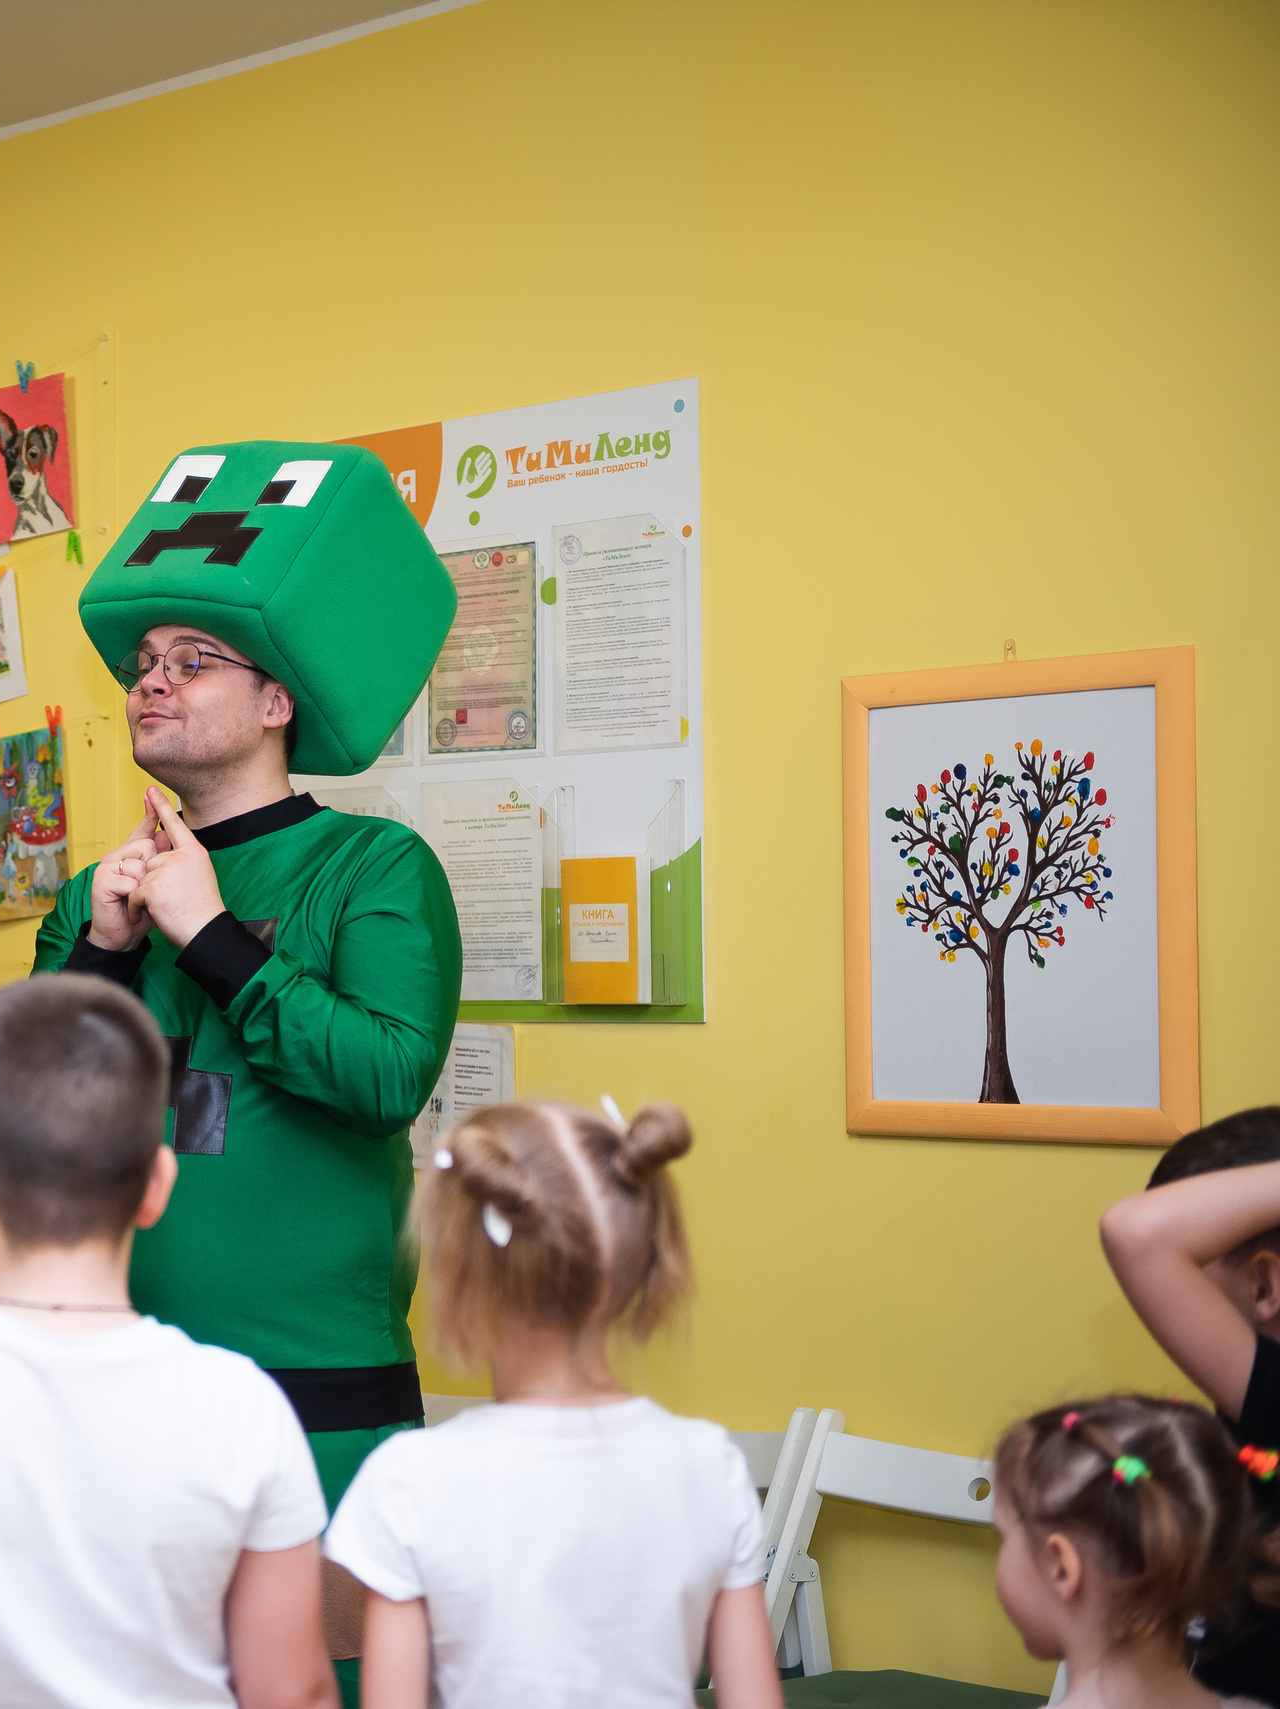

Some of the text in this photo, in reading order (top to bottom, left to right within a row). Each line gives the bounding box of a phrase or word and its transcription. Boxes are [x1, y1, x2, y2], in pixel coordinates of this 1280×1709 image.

[505, 429, 671, 475] ТиМиЛенд
[507, 478, 526, 488] Ваш
[528, 473, 567, 487] ребенок
[575, 467, 600, 477] наша
[602, 458, 649, 474] гордость!
[582, 909, 615, 920] КНИГА
